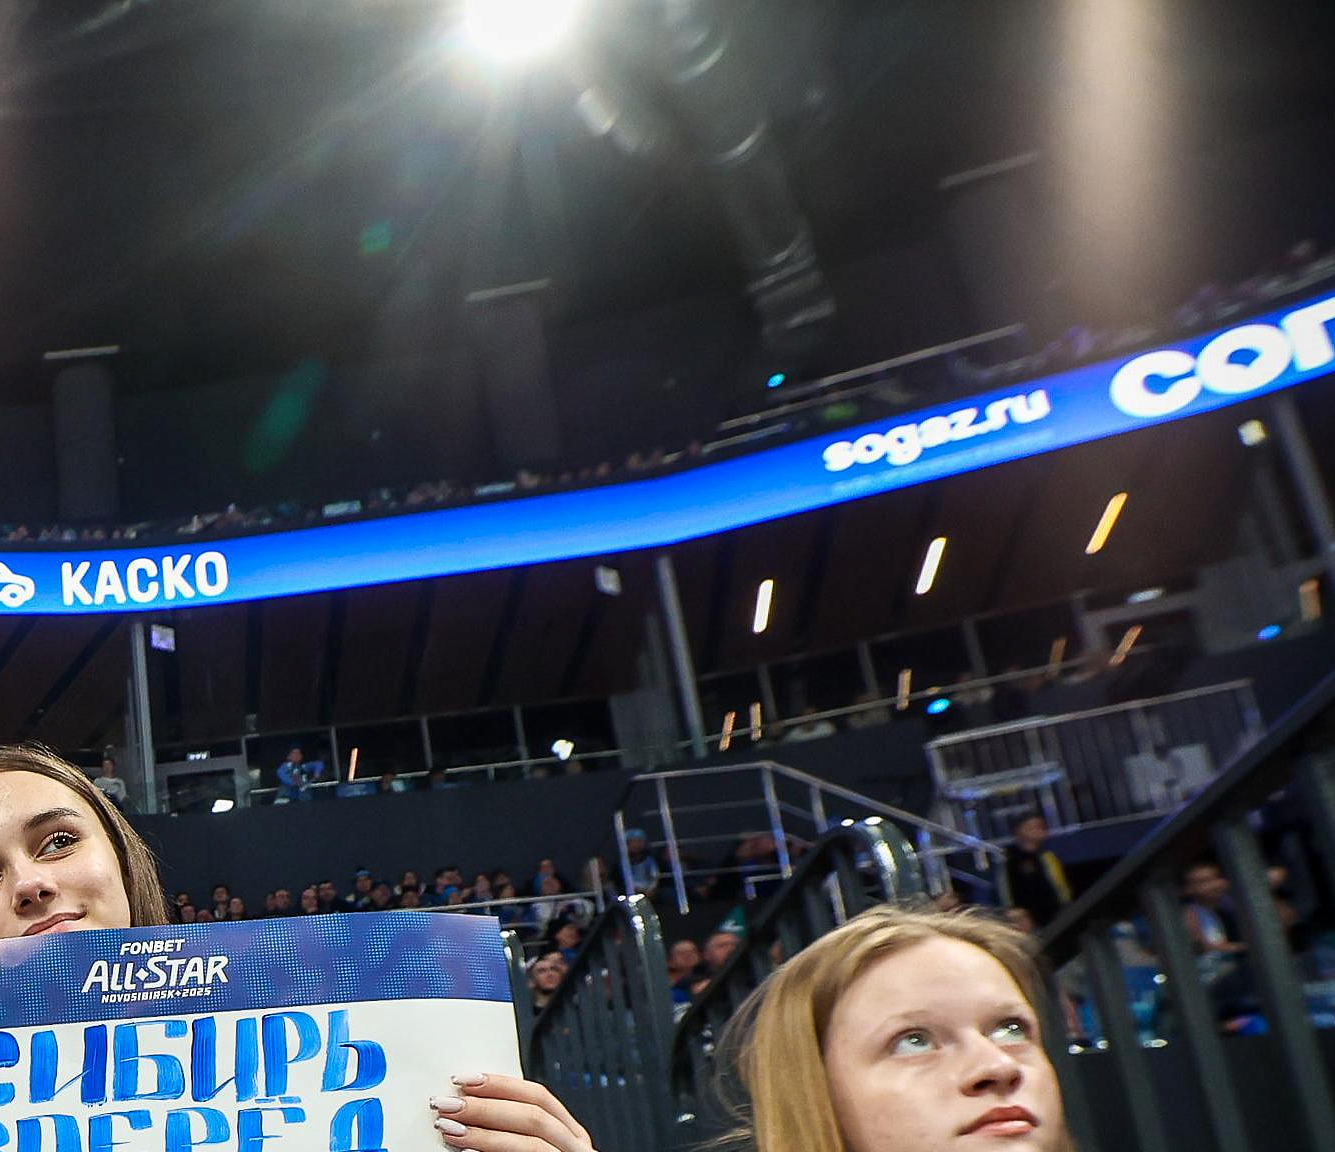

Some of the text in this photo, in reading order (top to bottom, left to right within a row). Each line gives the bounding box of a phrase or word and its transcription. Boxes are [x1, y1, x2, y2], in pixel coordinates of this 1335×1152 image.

[822, 389, 1051, 472] sogaz.ru
[61, 550, 229, 607] КАСКО
[120, 938, 185, 956] FONBET
